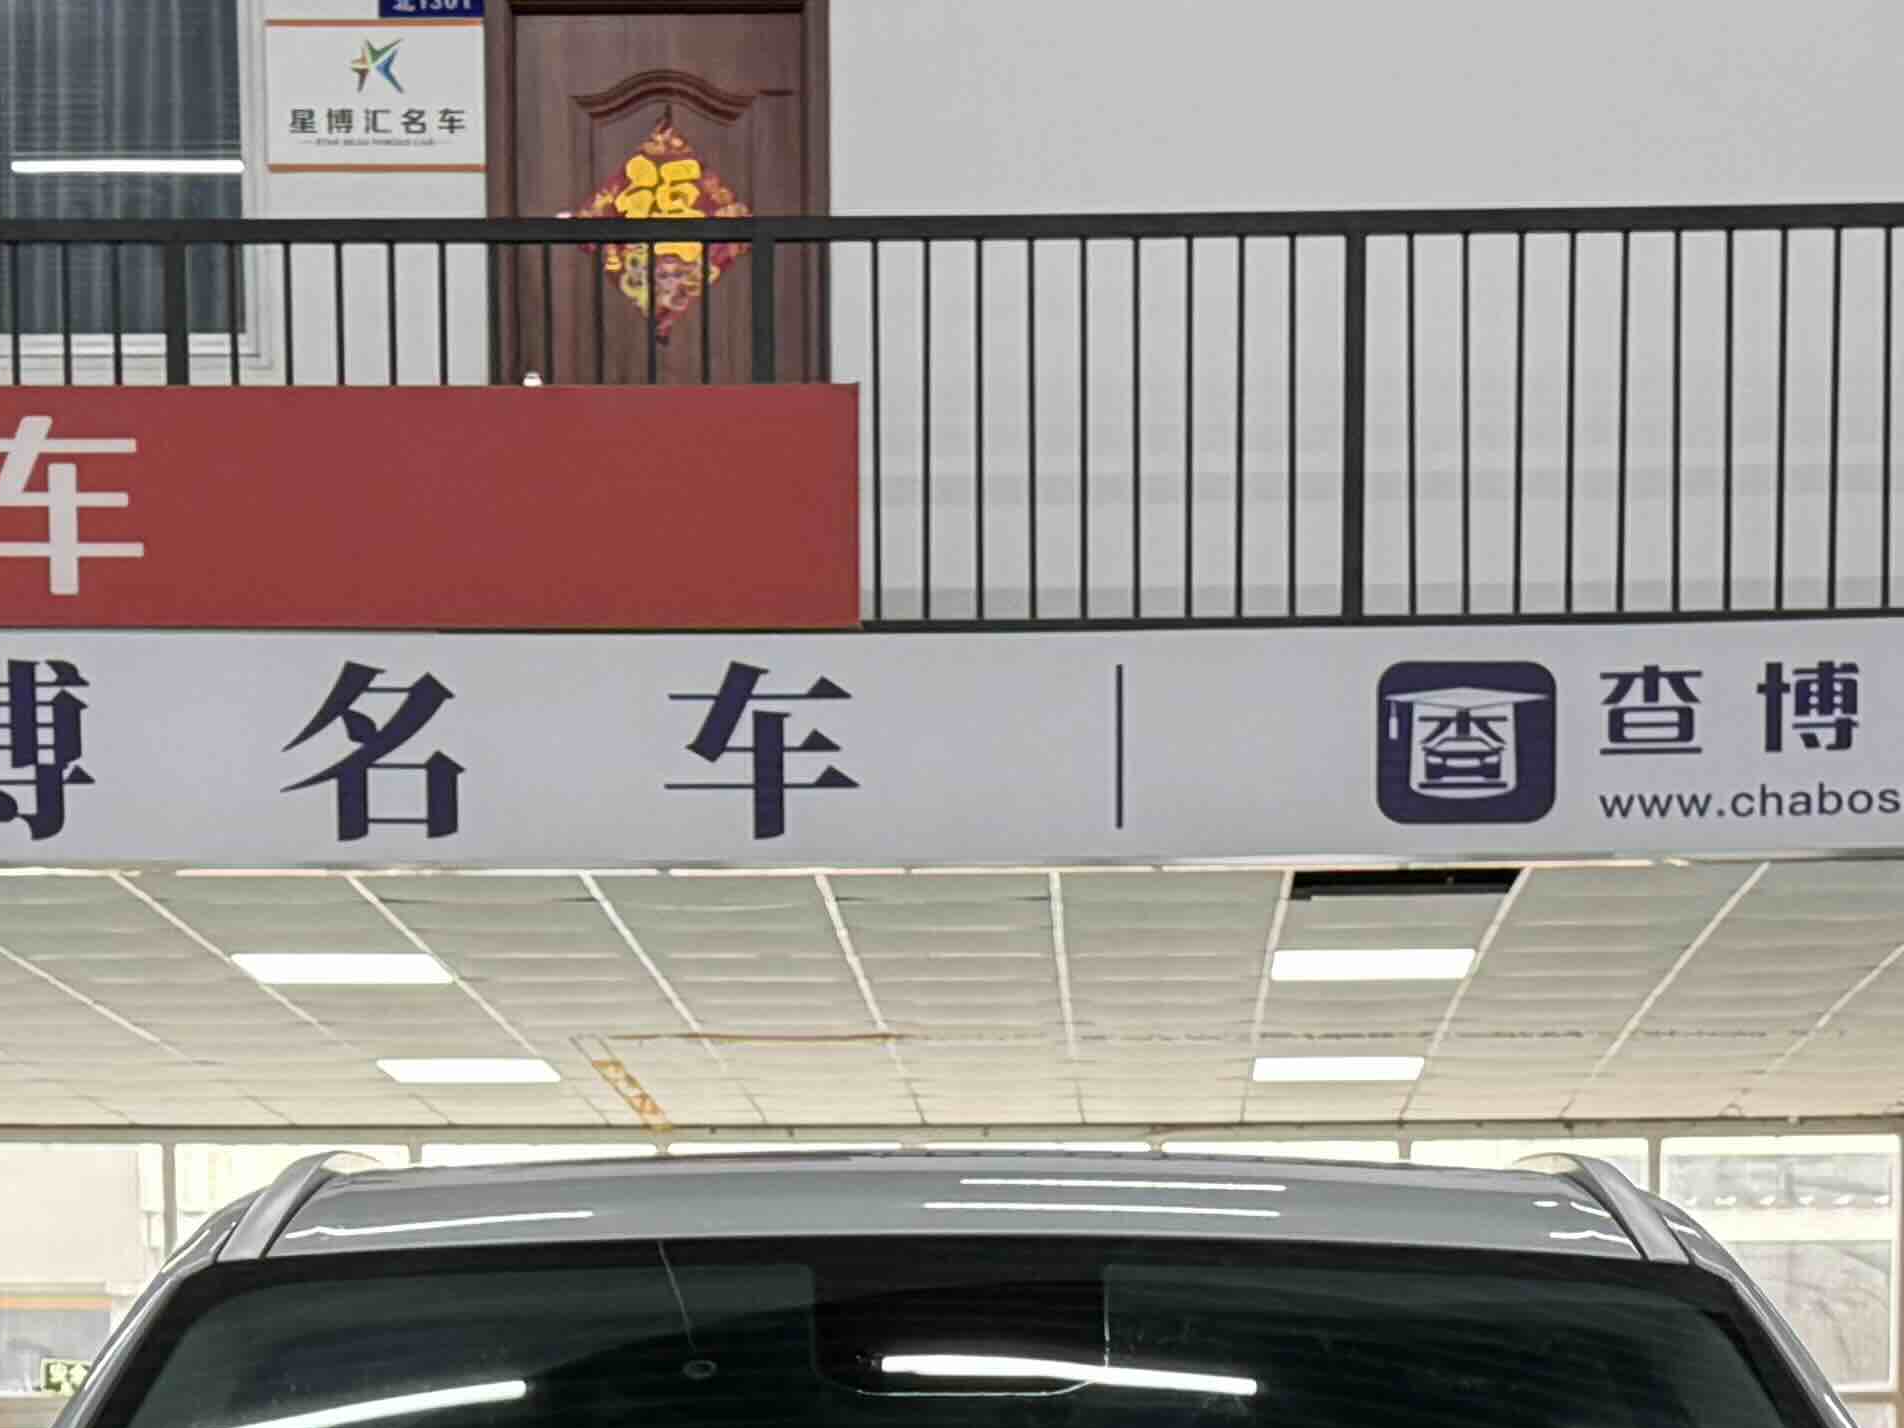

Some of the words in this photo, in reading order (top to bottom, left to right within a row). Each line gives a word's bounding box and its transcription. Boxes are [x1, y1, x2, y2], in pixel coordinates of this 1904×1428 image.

[289, 107, 466, 134] 星博汇名车
